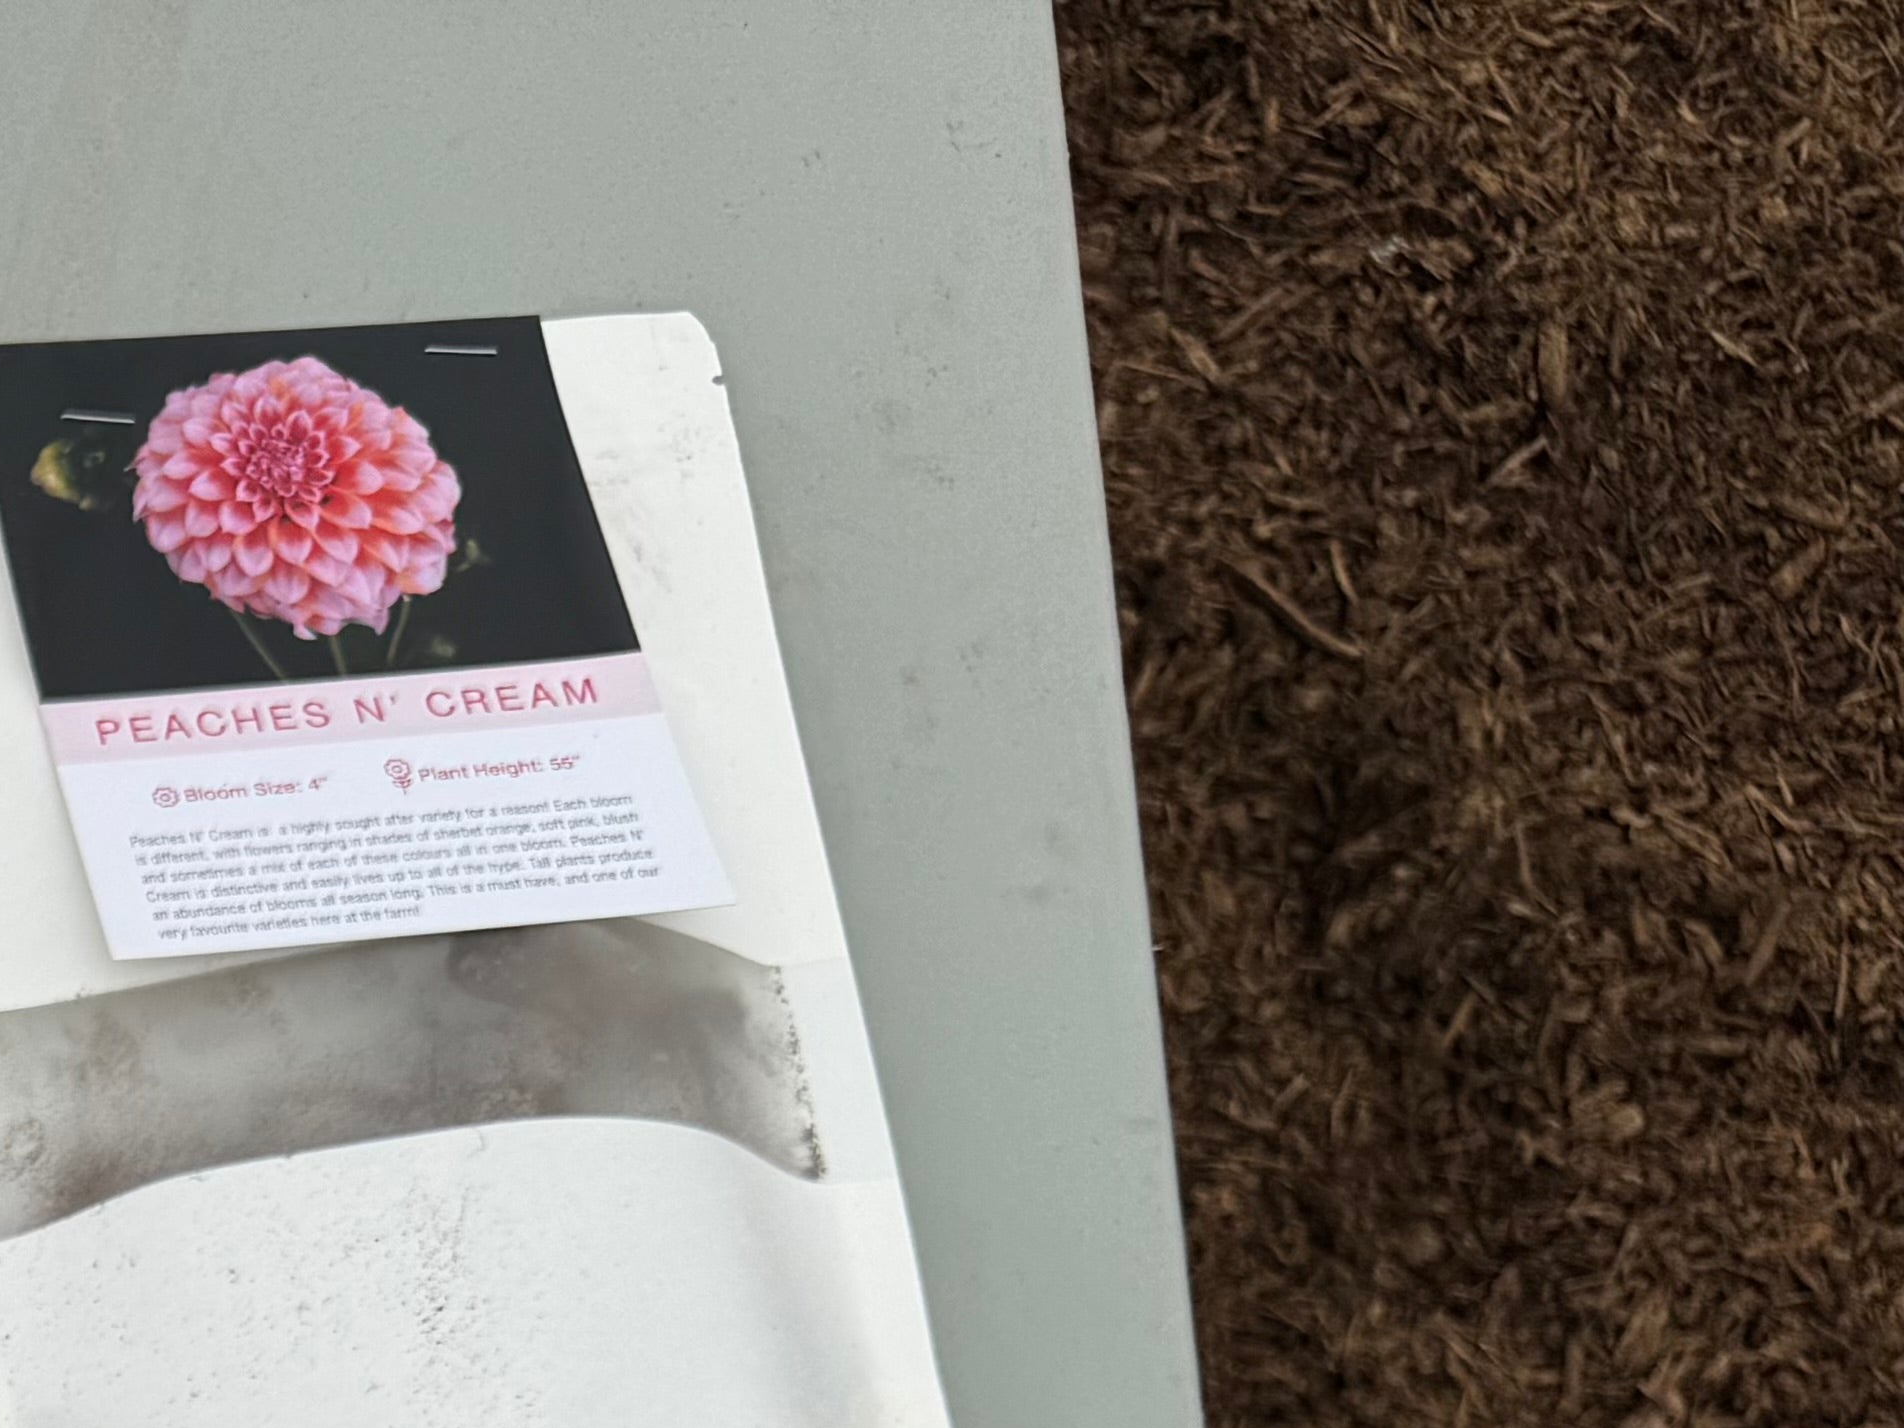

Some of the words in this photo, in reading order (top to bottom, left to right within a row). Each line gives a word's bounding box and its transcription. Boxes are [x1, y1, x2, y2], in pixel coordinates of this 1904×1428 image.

[95, 702, 330, 746] PEACHES
[425, 678, 599, 718] CREAM
[418, 764, 470, 783] Plant
[475, 759, 543, 779] Height:
[184, 782, 248, 802] Bloom
[255, 778, 303, 798] Size:
